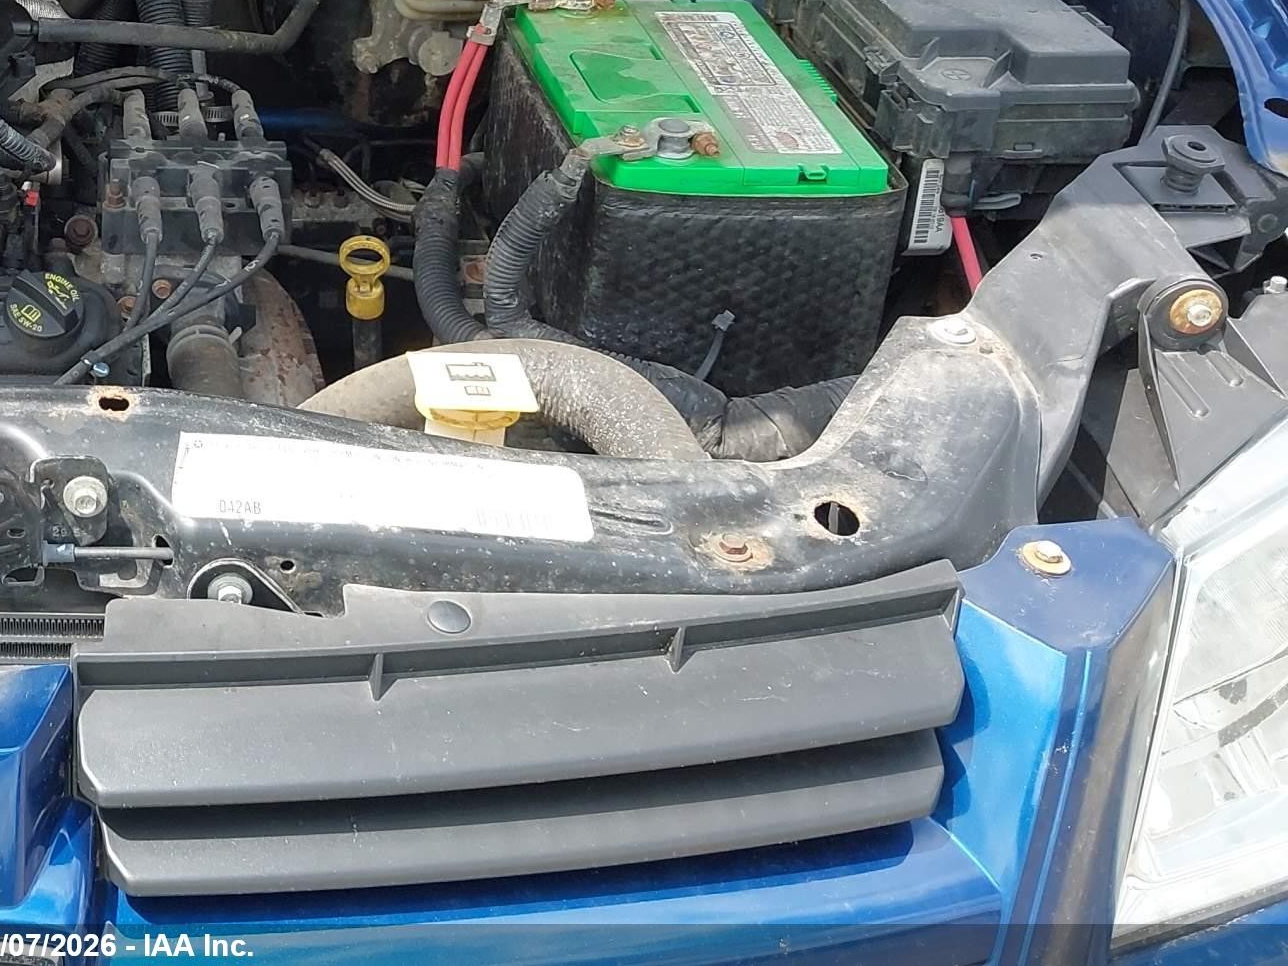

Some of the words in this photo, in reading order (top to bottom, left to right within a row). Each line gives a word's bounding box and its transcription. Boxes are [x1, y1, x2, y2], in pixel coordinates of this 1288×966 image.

[44, 273, 74, 291] ENGINE
[69, 289, 80, 302] OIL
[19, 317, 43, 332] 5W-20
